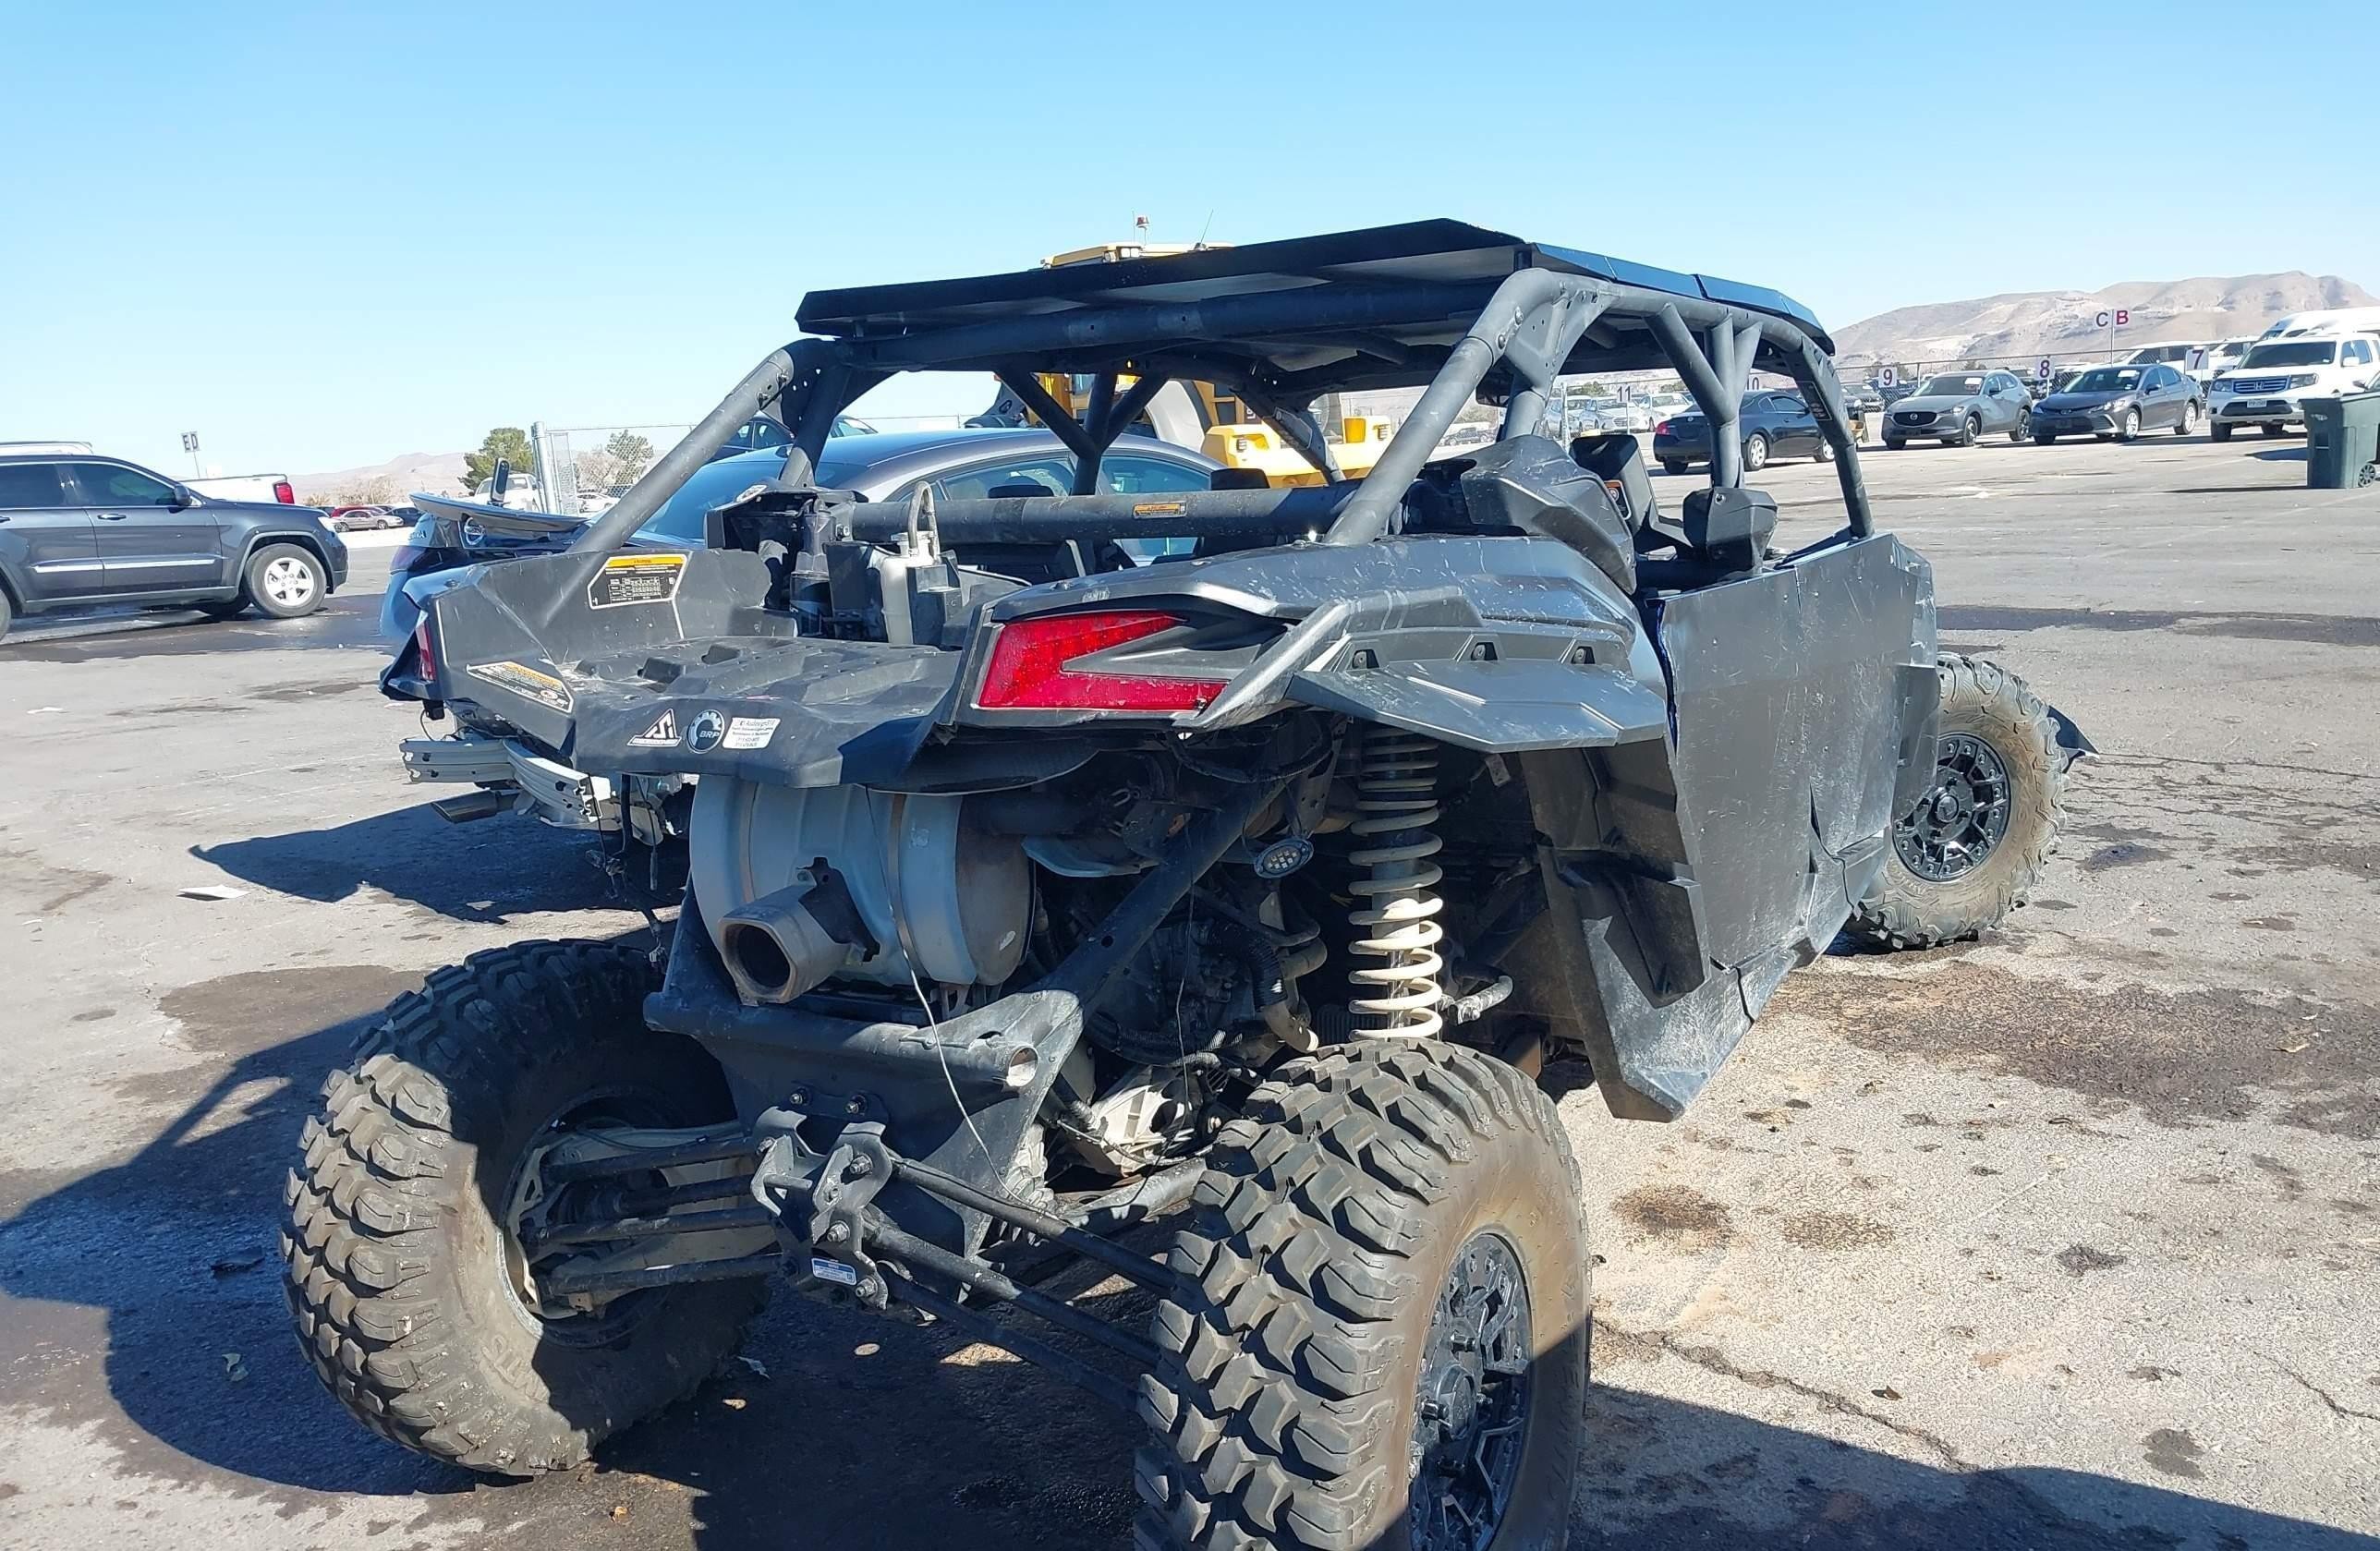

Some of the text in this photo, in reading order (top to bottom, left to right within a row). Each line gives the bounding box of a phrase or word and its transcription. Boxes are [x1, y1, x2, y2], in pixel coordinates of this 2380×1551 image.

[2096, 309, 2129, 327] C B
[2192, 349, 2204, 370] 7
[2040, 359, 2050, 378] 8
[1883, 369, 1893, 386] 9
[1617, 385, 1631, 402] 11
[699, 730, 721, 738] BRP
